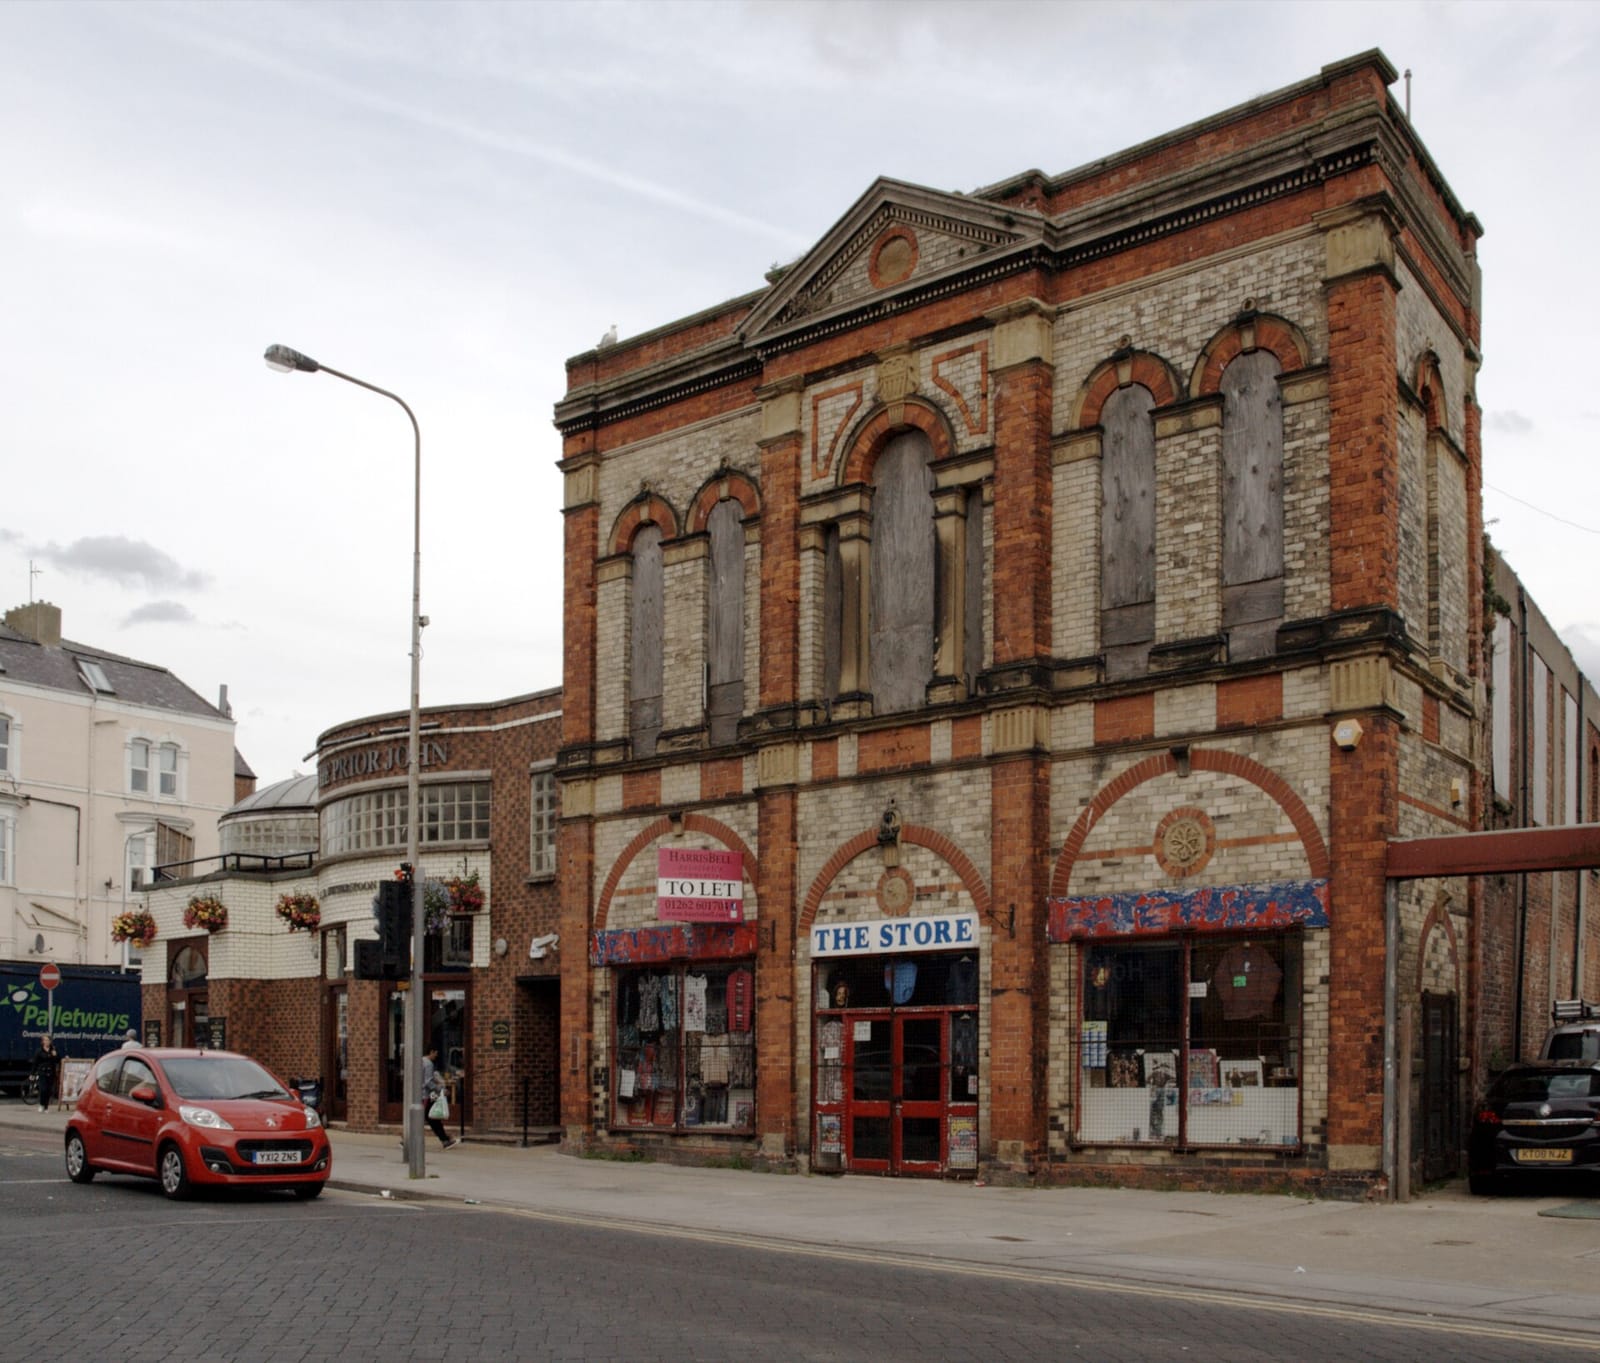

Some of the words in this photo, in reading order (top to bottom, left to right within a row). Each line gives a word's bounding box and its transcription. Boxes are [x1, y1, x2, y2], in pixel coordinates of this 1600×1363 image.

[331, 749, 379, 781] PRIOR
[384, 740, 448, 771] JOHN
[666, 880, 694, 896] TO
[700, 881, 736, 897] LET
[664, 900, 694, 911] 01262
[815, 926, 870, 951] THE
[879, 918, 973, 948] STORE
[22, 1004, 130, 1034] Palletways
[281, 1152, 298, 1162] ZNS
